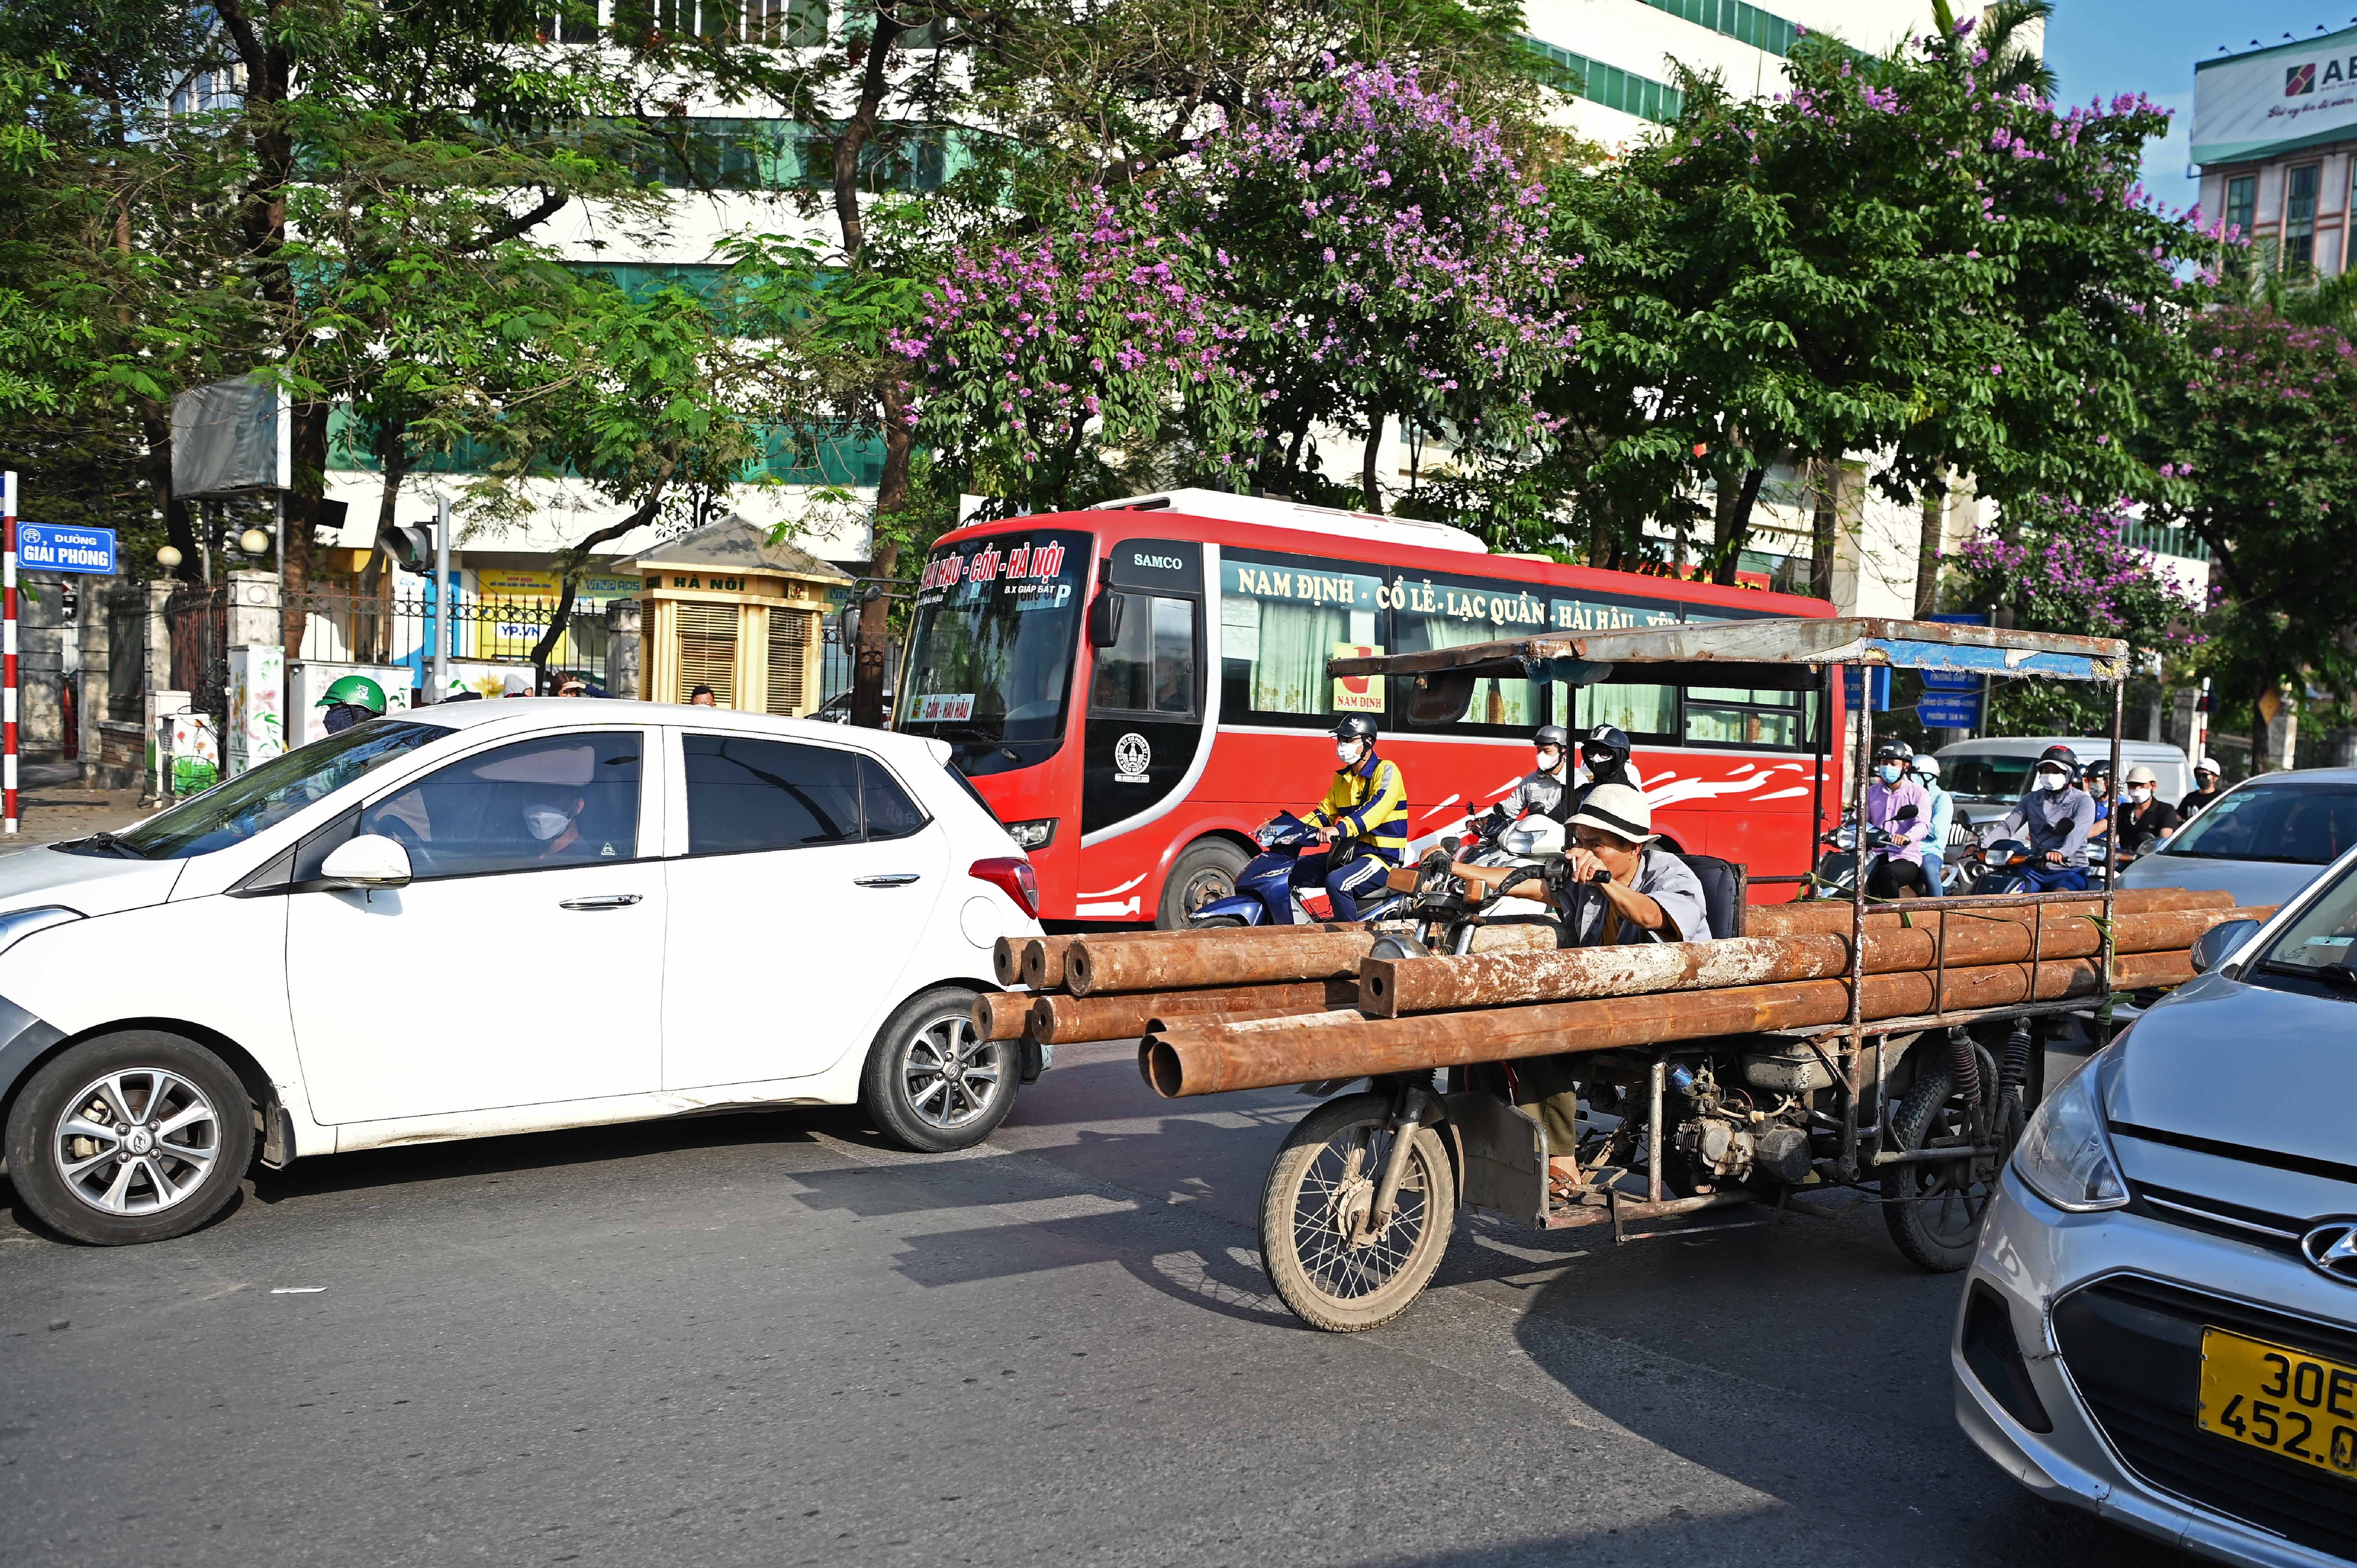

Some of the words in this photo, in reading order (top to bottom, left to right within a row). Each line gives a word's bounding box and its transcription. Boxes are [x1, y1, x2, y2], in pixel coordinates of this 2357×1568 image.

[55, 534, 97, 545] ĐƯỜNG
[24, 540, 54, 562] GIẢI
[58, 546, 108, 566] PHÓNG
[935, 551, 963, 592] HẬU
[1006, 542, 1030, 579] HÀ
[1030, 540, 1065, 584] NỘI
[1134, 554, 1182, 569] SAMCO
[674, 574, 700, 588] HÀ
[1018, 584, 1036, 593] GIÁP
[1238, 568, 1291, 597] NAM
[1297, 574, 1354, 606] ĐỊNH
[1447, 593, 1486, 622] LẠC
[1490, 591, 1545, 625] QUẦN
[1558, 600, 1592, 630] HẢI
[1338, 696, 1357, 706] NAM
[1360, 697, 1381, 710] ĐỊNH
[2261, 1353, 2357, 1421] 30E
